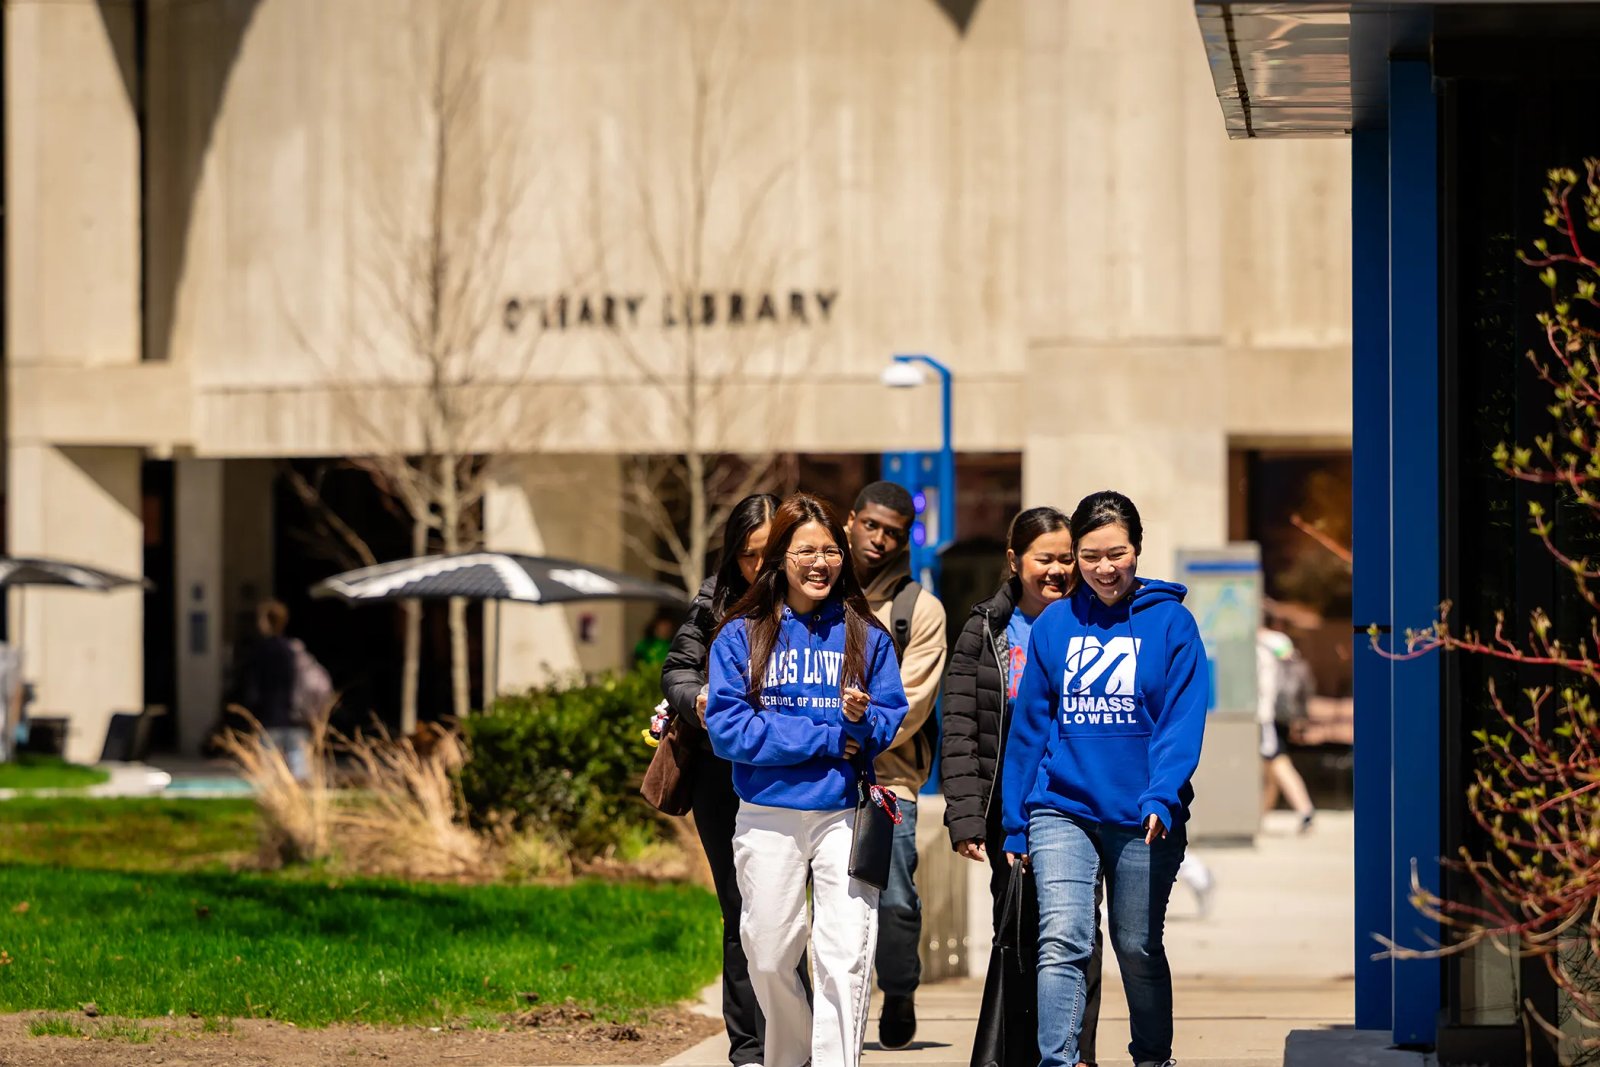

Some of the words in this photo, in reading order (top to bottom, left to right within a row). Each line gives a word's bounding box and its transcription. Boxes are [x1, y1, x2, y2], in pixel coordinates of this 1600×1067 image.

[662, 289, 839, 328] LIBRARY
[748, 649, 798, 688] ASS
[803, 648, 846, 687] LOW
[797, 696, 809, 707] OF
[812, 697, 841, 708] NURSI
[1063, 696, 1136, 713] UMASS
[1063, 713, 1137, 725] LOWELL
